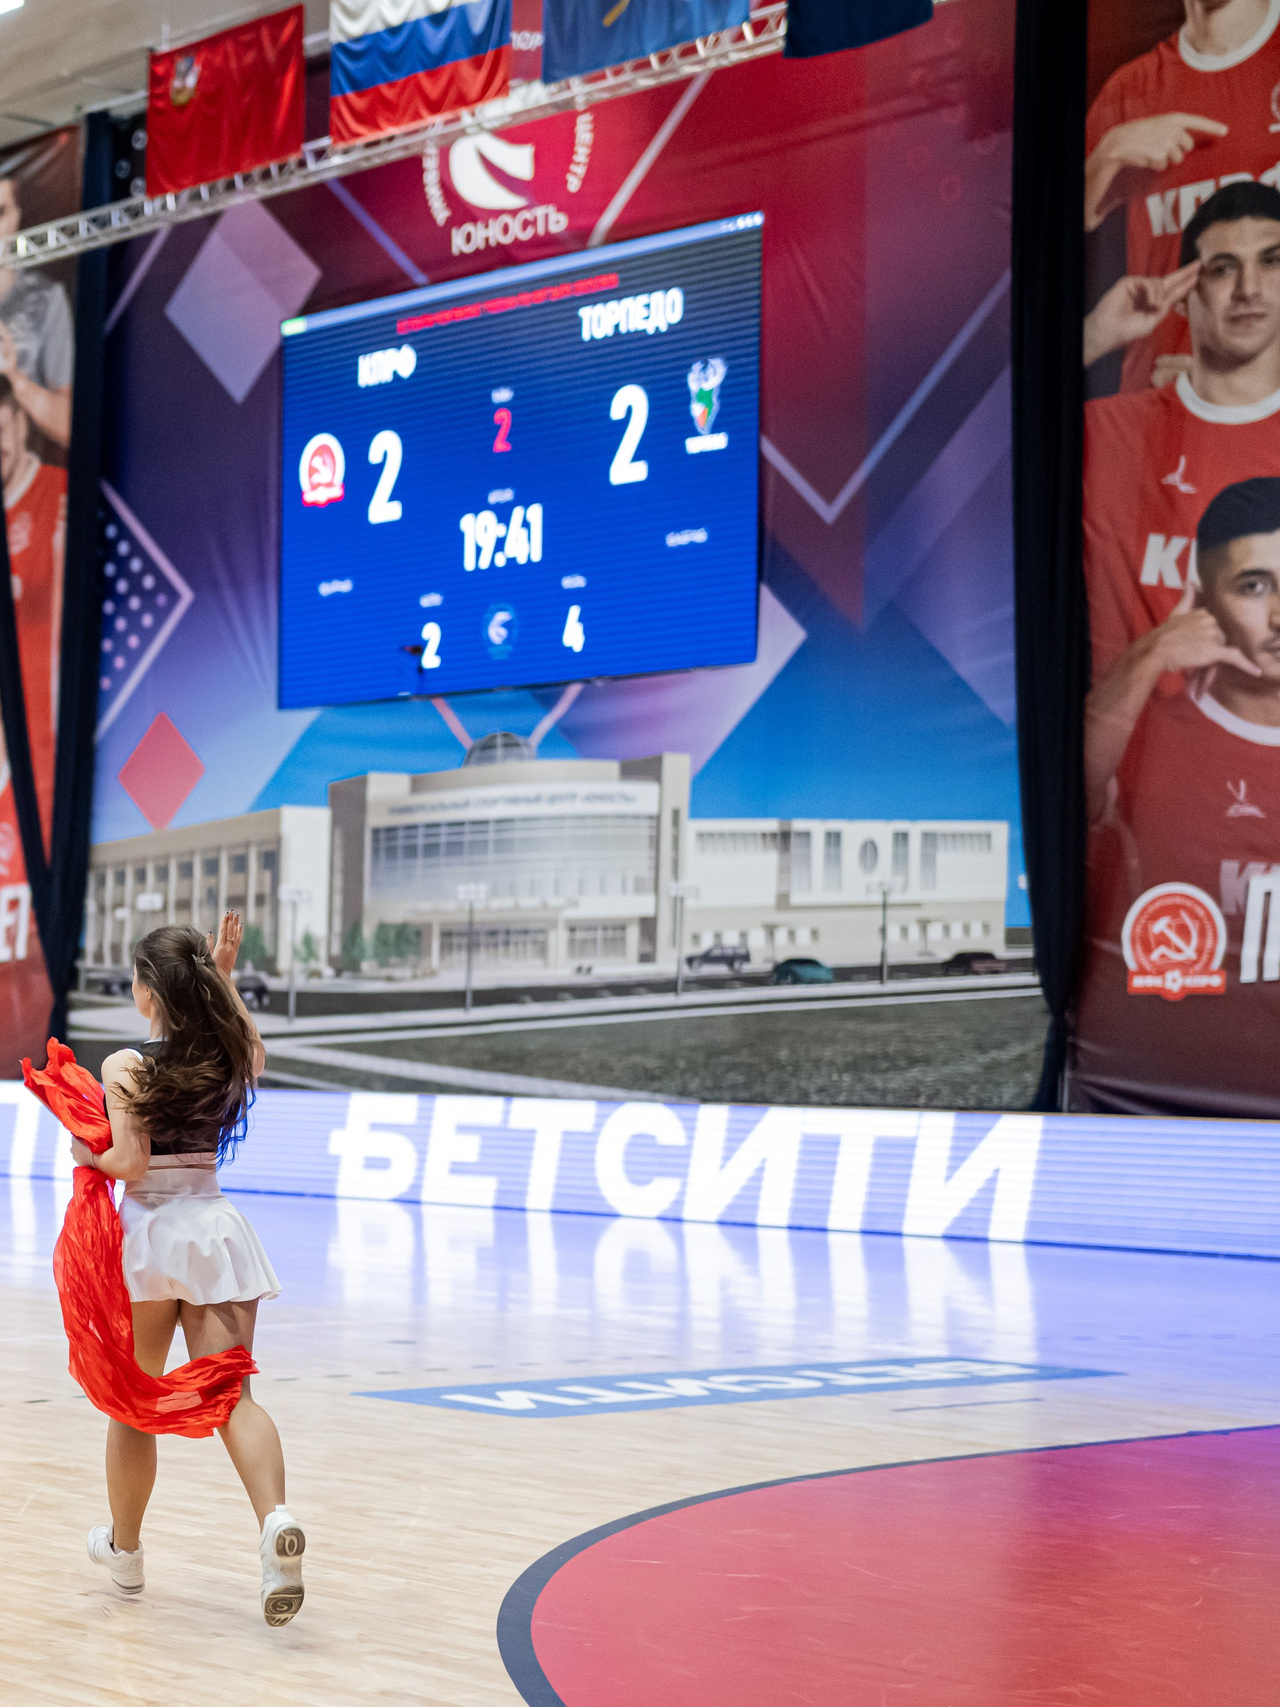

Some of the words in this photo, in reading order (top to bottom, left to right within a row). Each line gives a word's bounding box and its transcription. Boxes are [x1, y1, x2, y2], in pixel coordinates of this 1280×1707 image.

[450, 204, 569, 256] ЮНОСТЬ
[578, 286, 684, 342] ТОРПЕДО
[493, 408, 512, 453] 2
[609, 384, 649, 485] 2
[368, 430, 403, 524] 2
[460, 503, 543, 572] 19:41
[421, 621, 441, 669] 2
[562, 604, 586, 652] 4
[327, 1092, 1044, 1241] БЕТСИТИ
